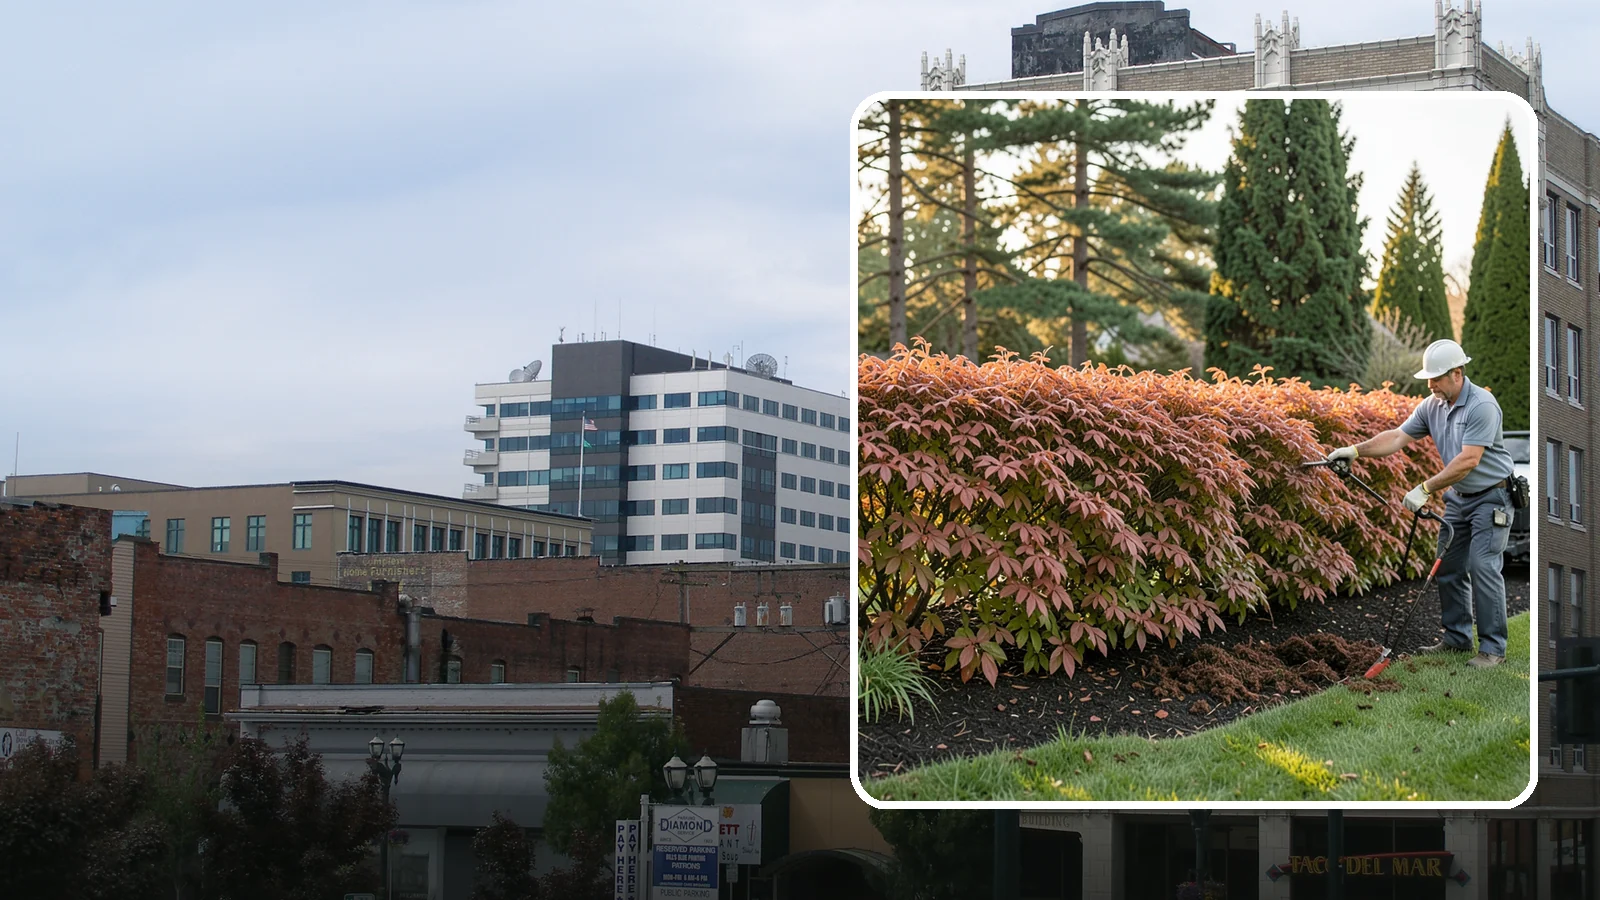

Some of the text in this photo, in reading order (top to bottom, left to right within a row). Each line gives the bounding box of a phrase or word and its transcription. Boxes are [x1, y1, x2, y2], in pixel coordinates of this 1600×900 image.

[343, 566, 427, 578] Home Furnishers
[660, 818, 713, 832] DIAMOND
[1022, 815, 1069, 828] BUILDING
[689, 846, 716, 854] PARKING
[616, 825, 625, 894] PAY HERE
[628, 825, 637, 894] PAY HERE
[722, 851, 739, 862] Soup
[672, 862, 701, 870] PATRONS
[1346, 856, 1385, 877] DEL
[1392, 857, 1442, 877] MAR
[660, 889, 710, 898] PUBLIC PARKING
